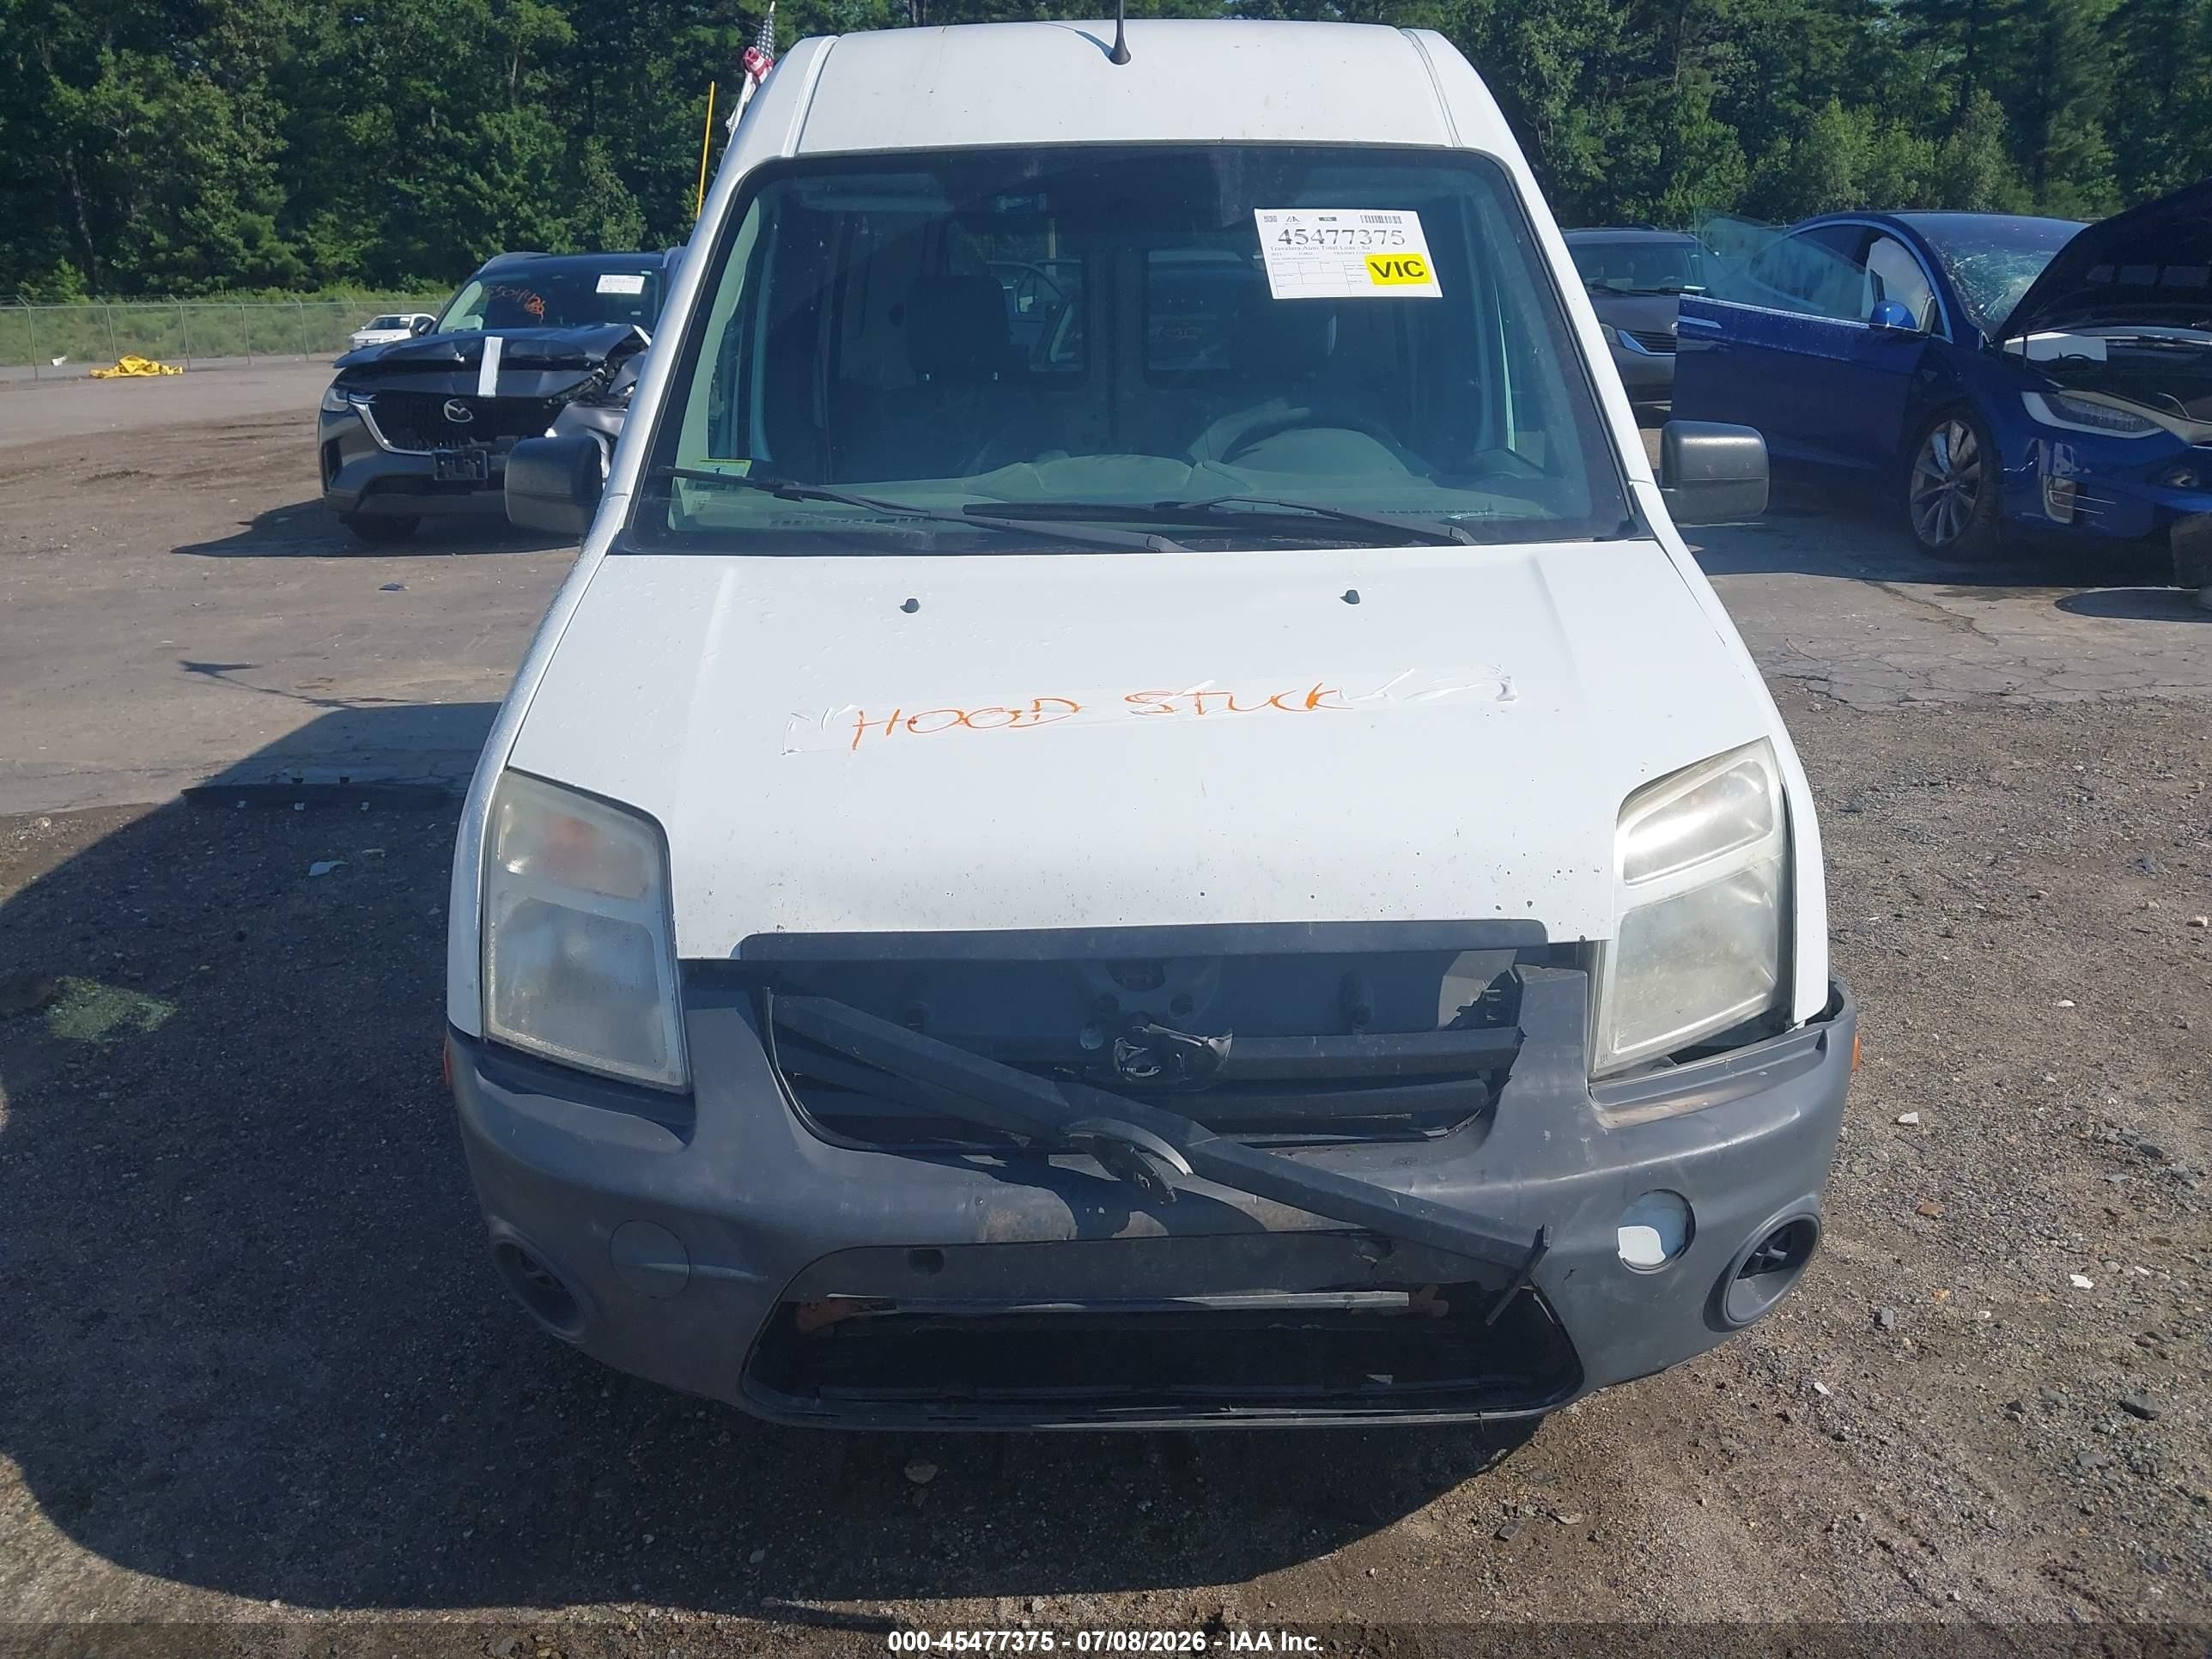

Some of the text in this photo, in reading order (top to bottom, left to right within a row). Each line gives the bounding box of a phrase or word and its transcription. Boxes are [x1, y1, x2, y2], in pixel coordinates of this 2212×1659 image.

[1277, 228, 1407, 246] 45477375
[1370, 260, 1425, 278] VIC
[852, 681, 1354, 750] HOOD STUCK
